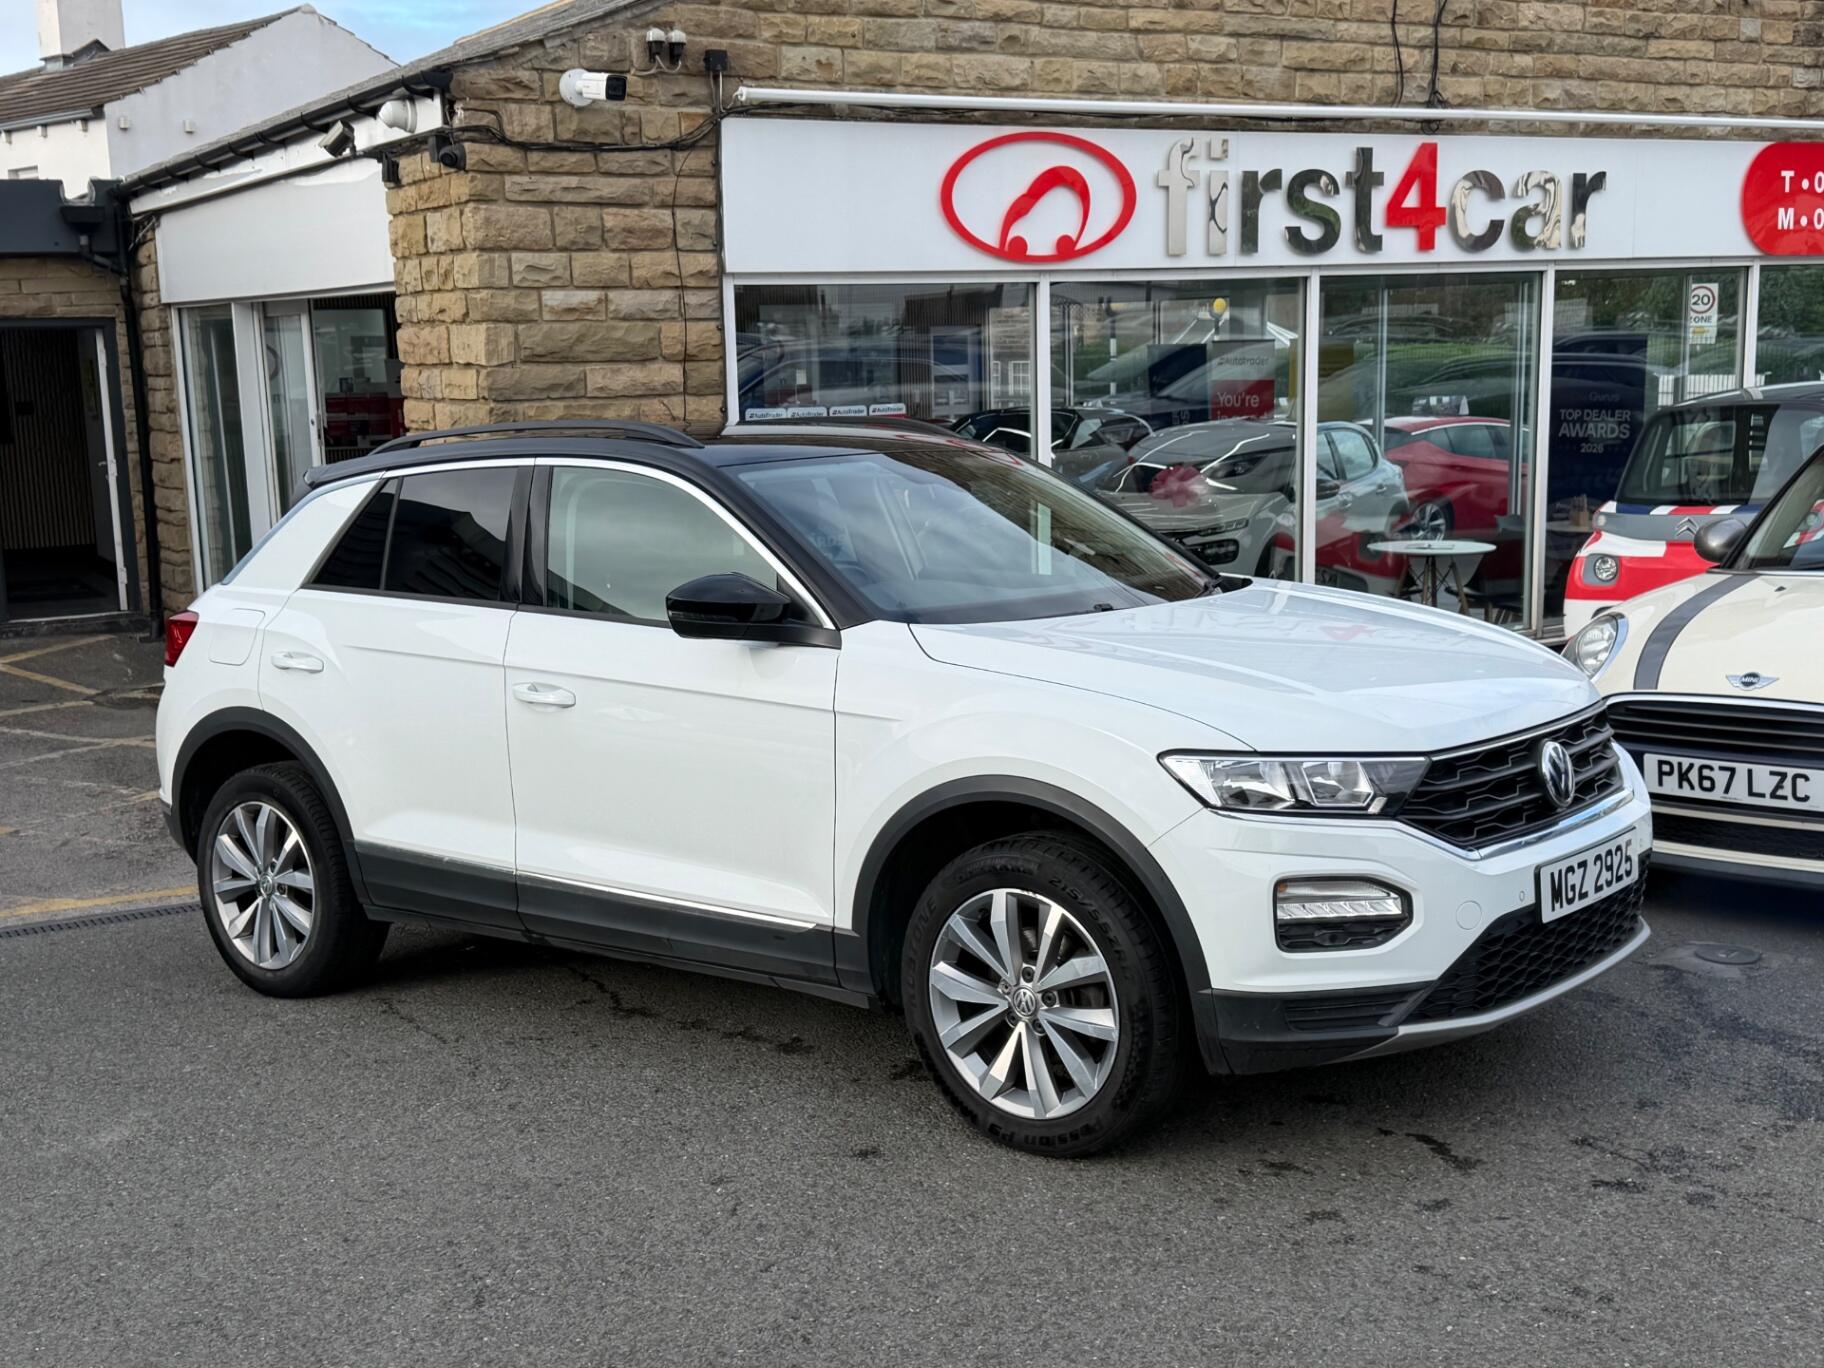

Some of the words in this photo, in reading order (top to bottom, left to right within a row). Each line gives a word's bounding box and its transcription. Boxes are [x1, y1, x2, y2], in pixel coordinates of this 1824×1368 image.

[1157, 136, 1607, 256] first4car
[1692, 293, 1711, 306] 20
[1216, 392, 1260, 408] You're
[1560, 408, 1582, 421] TOP
[1583, 409, 1631, 422] DEALER
[1558, 422, 1631, 439] AWARDS
[1657, 759, 1737, 795] PK67
[1747, 768, 1811, 803] LZC
[1550, 859, 1589, 912] MGZ
[1593, 840, 1634, 895] 2925
